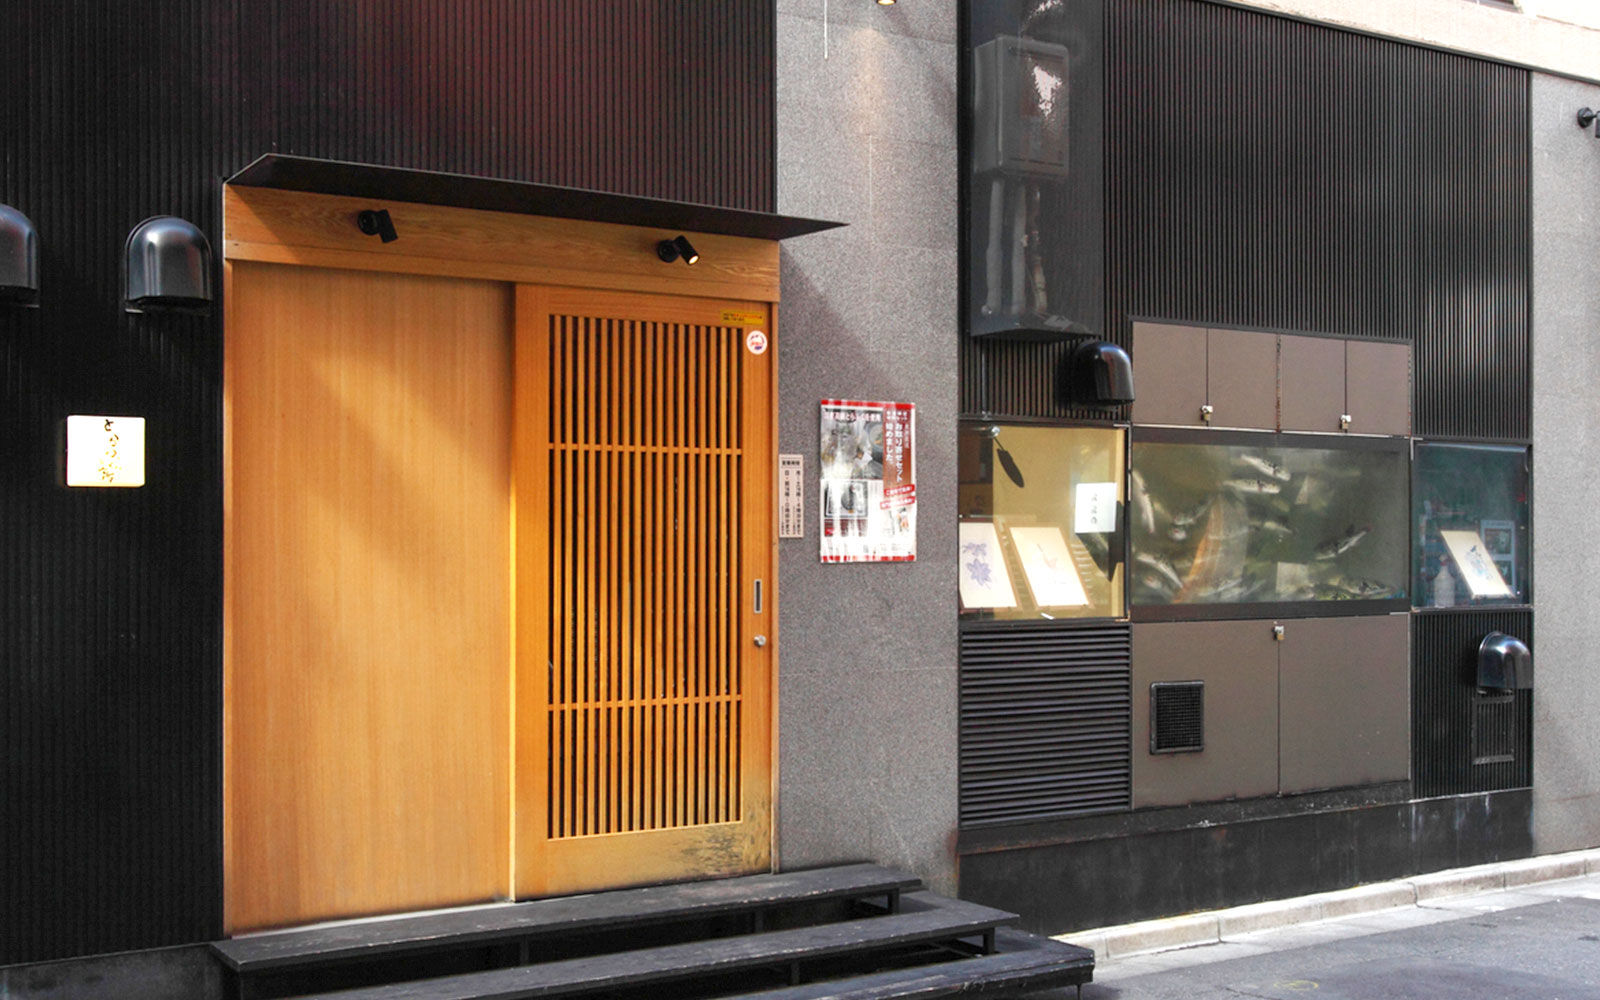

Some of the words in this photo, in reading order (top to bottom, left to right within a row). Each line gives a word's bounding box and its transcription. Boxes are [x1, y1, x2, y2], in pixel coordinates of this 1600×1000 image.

[895, 423, 904, 482] お取り寄せセット
